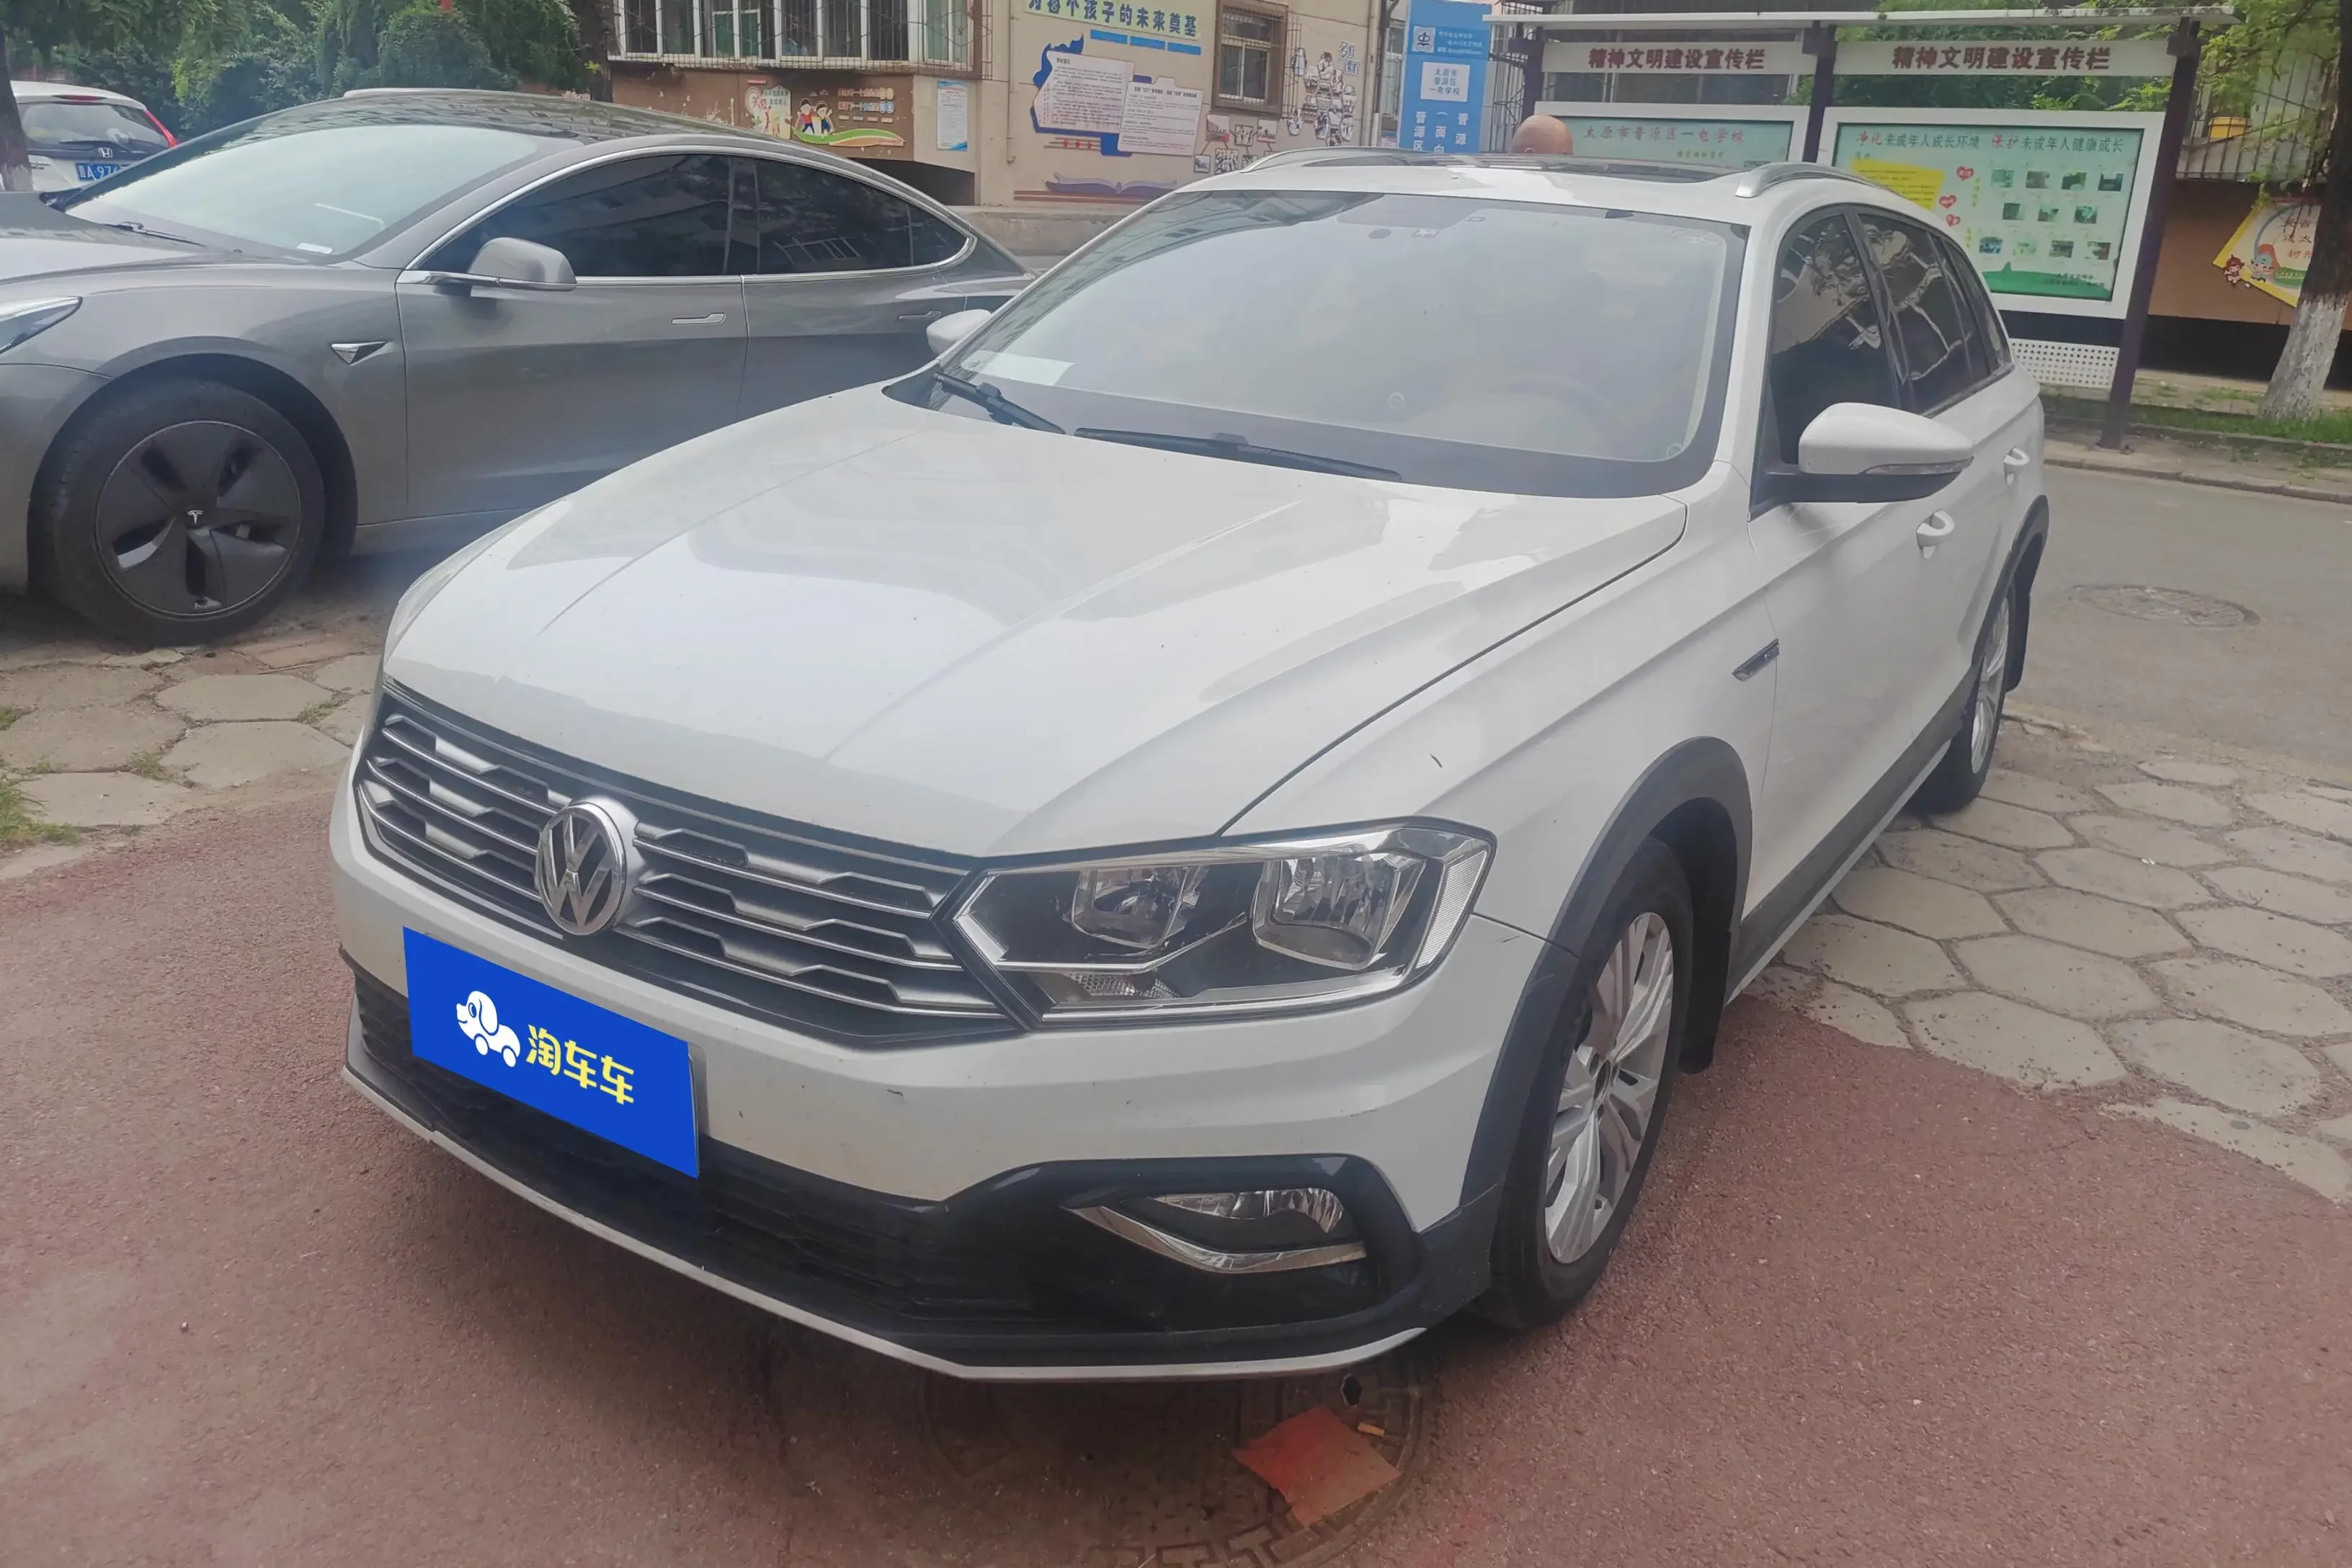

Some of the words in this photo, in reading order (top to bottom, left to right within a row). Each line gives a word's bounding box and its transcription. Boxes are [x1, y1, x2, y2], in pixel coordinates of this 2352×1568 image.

[1588, 48, 1765, 70] 精神文明建设宣传栏
[1892, 46, 2111, 69] 精神文明建设宣传栏
[1435, 68, 1458, 76] 太原市
[1429, 86, 1461, 95] 一电学校
[1584, 125, 1745, 143] 太原市晋源区一电学校
